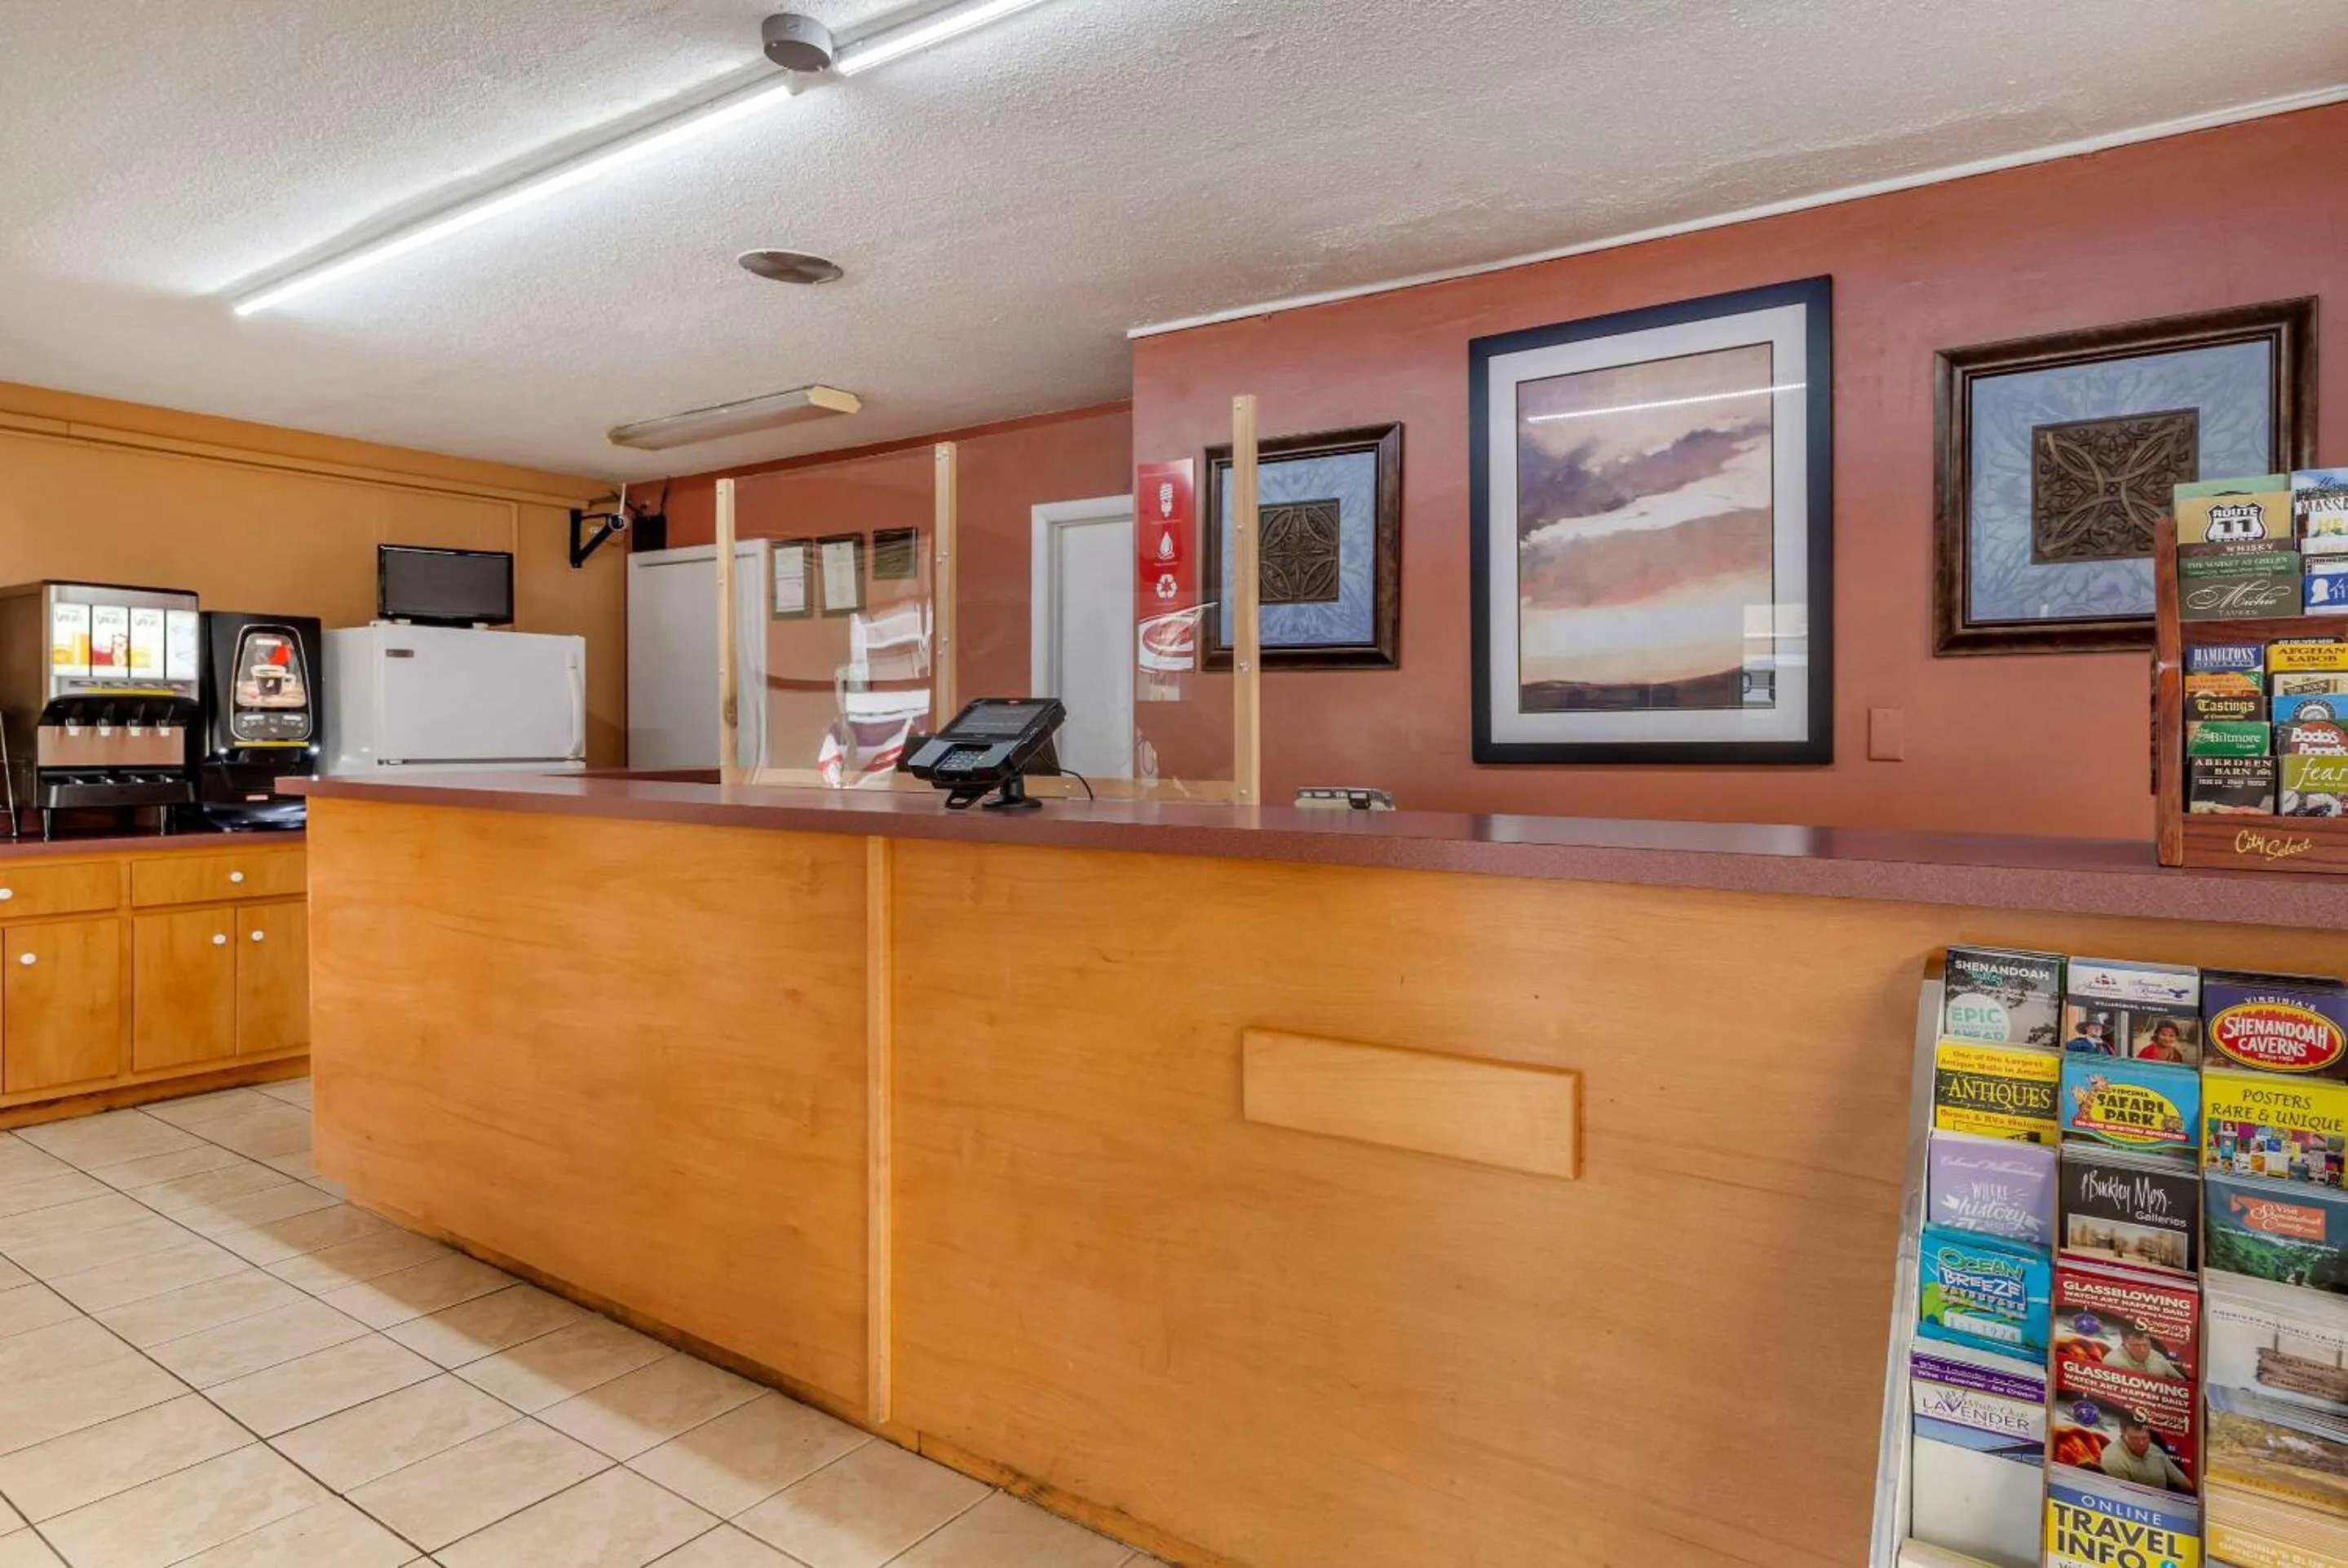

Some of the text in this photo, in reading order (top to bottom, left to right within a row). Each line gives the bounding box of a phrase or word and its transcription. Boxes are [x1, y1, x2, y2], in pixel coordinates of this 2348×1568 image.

[2213, 506, 2258, 518] ROUTE
[2218, 519, 2253, 533] 11
[2226, 543, 2274, 553] WHISKY
[2279, 647, 2346, 655] AFGHAN
[2287, 655, 2337, 663] KABOB
[2195, 699, 2255, 714] Tastings
[2210, 732, 2262, 743] Biltmore
[2290, 727, 2340, 744] Bodo's
[2194, 758, 2272, 767] ABERDEEN
[2214, 767, 2252, 775] BARN
[2235, 830, 2312, 861] City Select
[1954, 960, 2050, 981] SHENANDOAH
[1950, 1006, 2002, 1023] EPIC
[2244, 996, 2316, 1013] VIRGINIA'S
[1954, 1029, 2005, 1041] AHEAD
[2222, 1016, 2329, 1051] SHENANDOAH
[2238, 1035, 2307, 1058] CAVERNS
[1941, 1058, 1975, 1069] Antique
[1978, 1063, 2004, 1071] Malls
[2016, 1068, 2056, 1078] America
[1952, 1051, 1970, 1059] One
[2005, 1057, 2044, 1068] Largest
[1948, 1077, 2052, 1110] ANTIQUES
[2112, 1088, 2149, 1098] VIRGINIA
[2243, 1089, 2312, 1111] POSTERS
[2097, 1093, 2165, 1115] SAFARI
[2008, 1118, 2055, 1131] Welcome
[2104, 1107, 2156, 1126] PARK
[2211, 1102, 2344, 1133] RARE & UNIQUE
[1958, 1194, 2026, 1230] history
[2135, 1210, 2187, 1228] Galleries
[1940, 1267, 2023, 1298] BREEZE
[2063, 1280, 2191, 1310] GLASSBLOWING
[2064, 1290, 2191, 1318] WATCH ART HAPPEN DAILY
[1917, 1370, 1939, 1379] Wine
[1945, 1375, 1985, 1389] Lavender
[1990, 1384, 2005, 1393] Ice
[2063, 1360, 2189, 1399] GLASSBLOWING
[2063, 1371, 2190, 1407] WATCH ART HAPPEN DAILY
[1923, 1389, 2030, 1431] LAVENDER
[2080, 1495, 2161, 1526] ONLINE
[2053, 1502, 2183, 1560] TRAVEL
[2058, 1530, 2147, 1568] INFO
